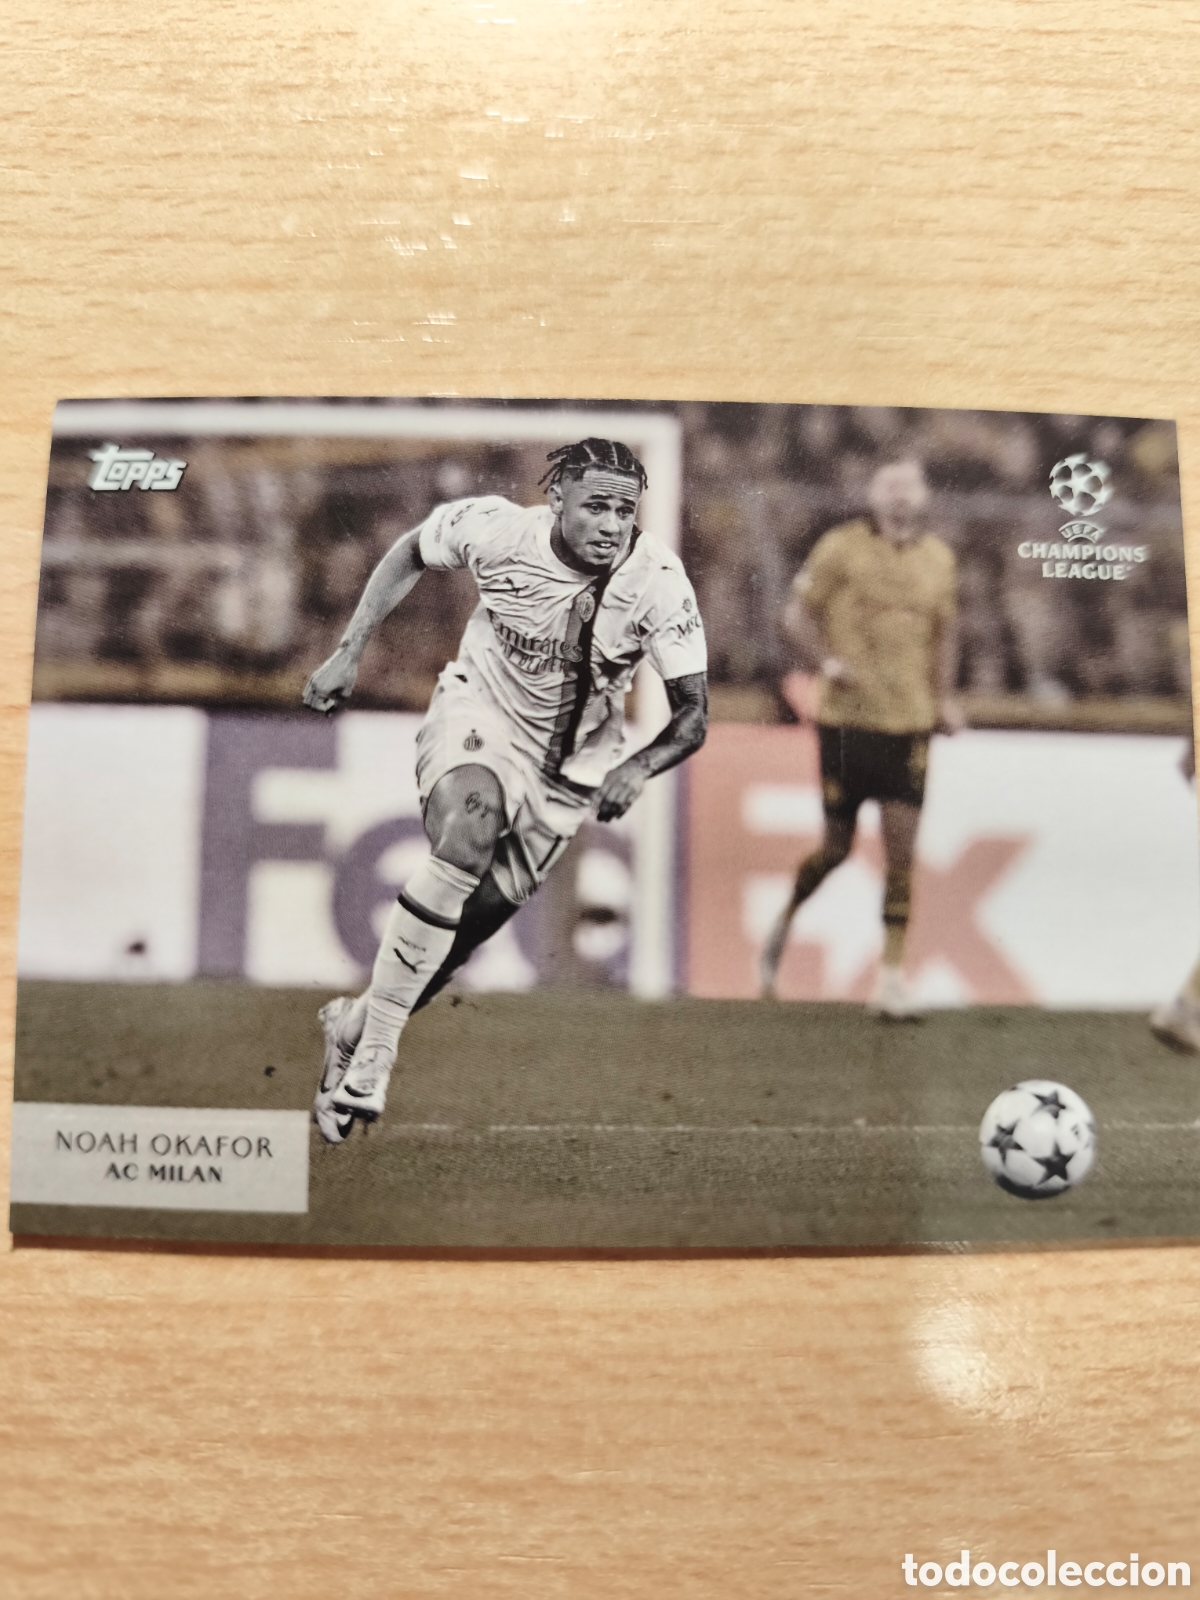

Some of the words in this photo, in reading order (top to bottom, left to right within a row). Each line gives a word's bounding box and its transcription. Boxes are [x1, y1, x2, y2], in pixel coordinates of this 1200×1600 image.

[1060, 522, 1101, 539] UEFA
[1017, 541, 1147, 563] CHAMPIONS
[1042, 561, 1128, 581] LEAGUE
[56, 1130, 138, 1154] NOAH
[151, 1134, 273, 1158] OKAFOR
[105, 1162, 139, 1180] AC
[150, 1164, 223, 1183] MILAN
